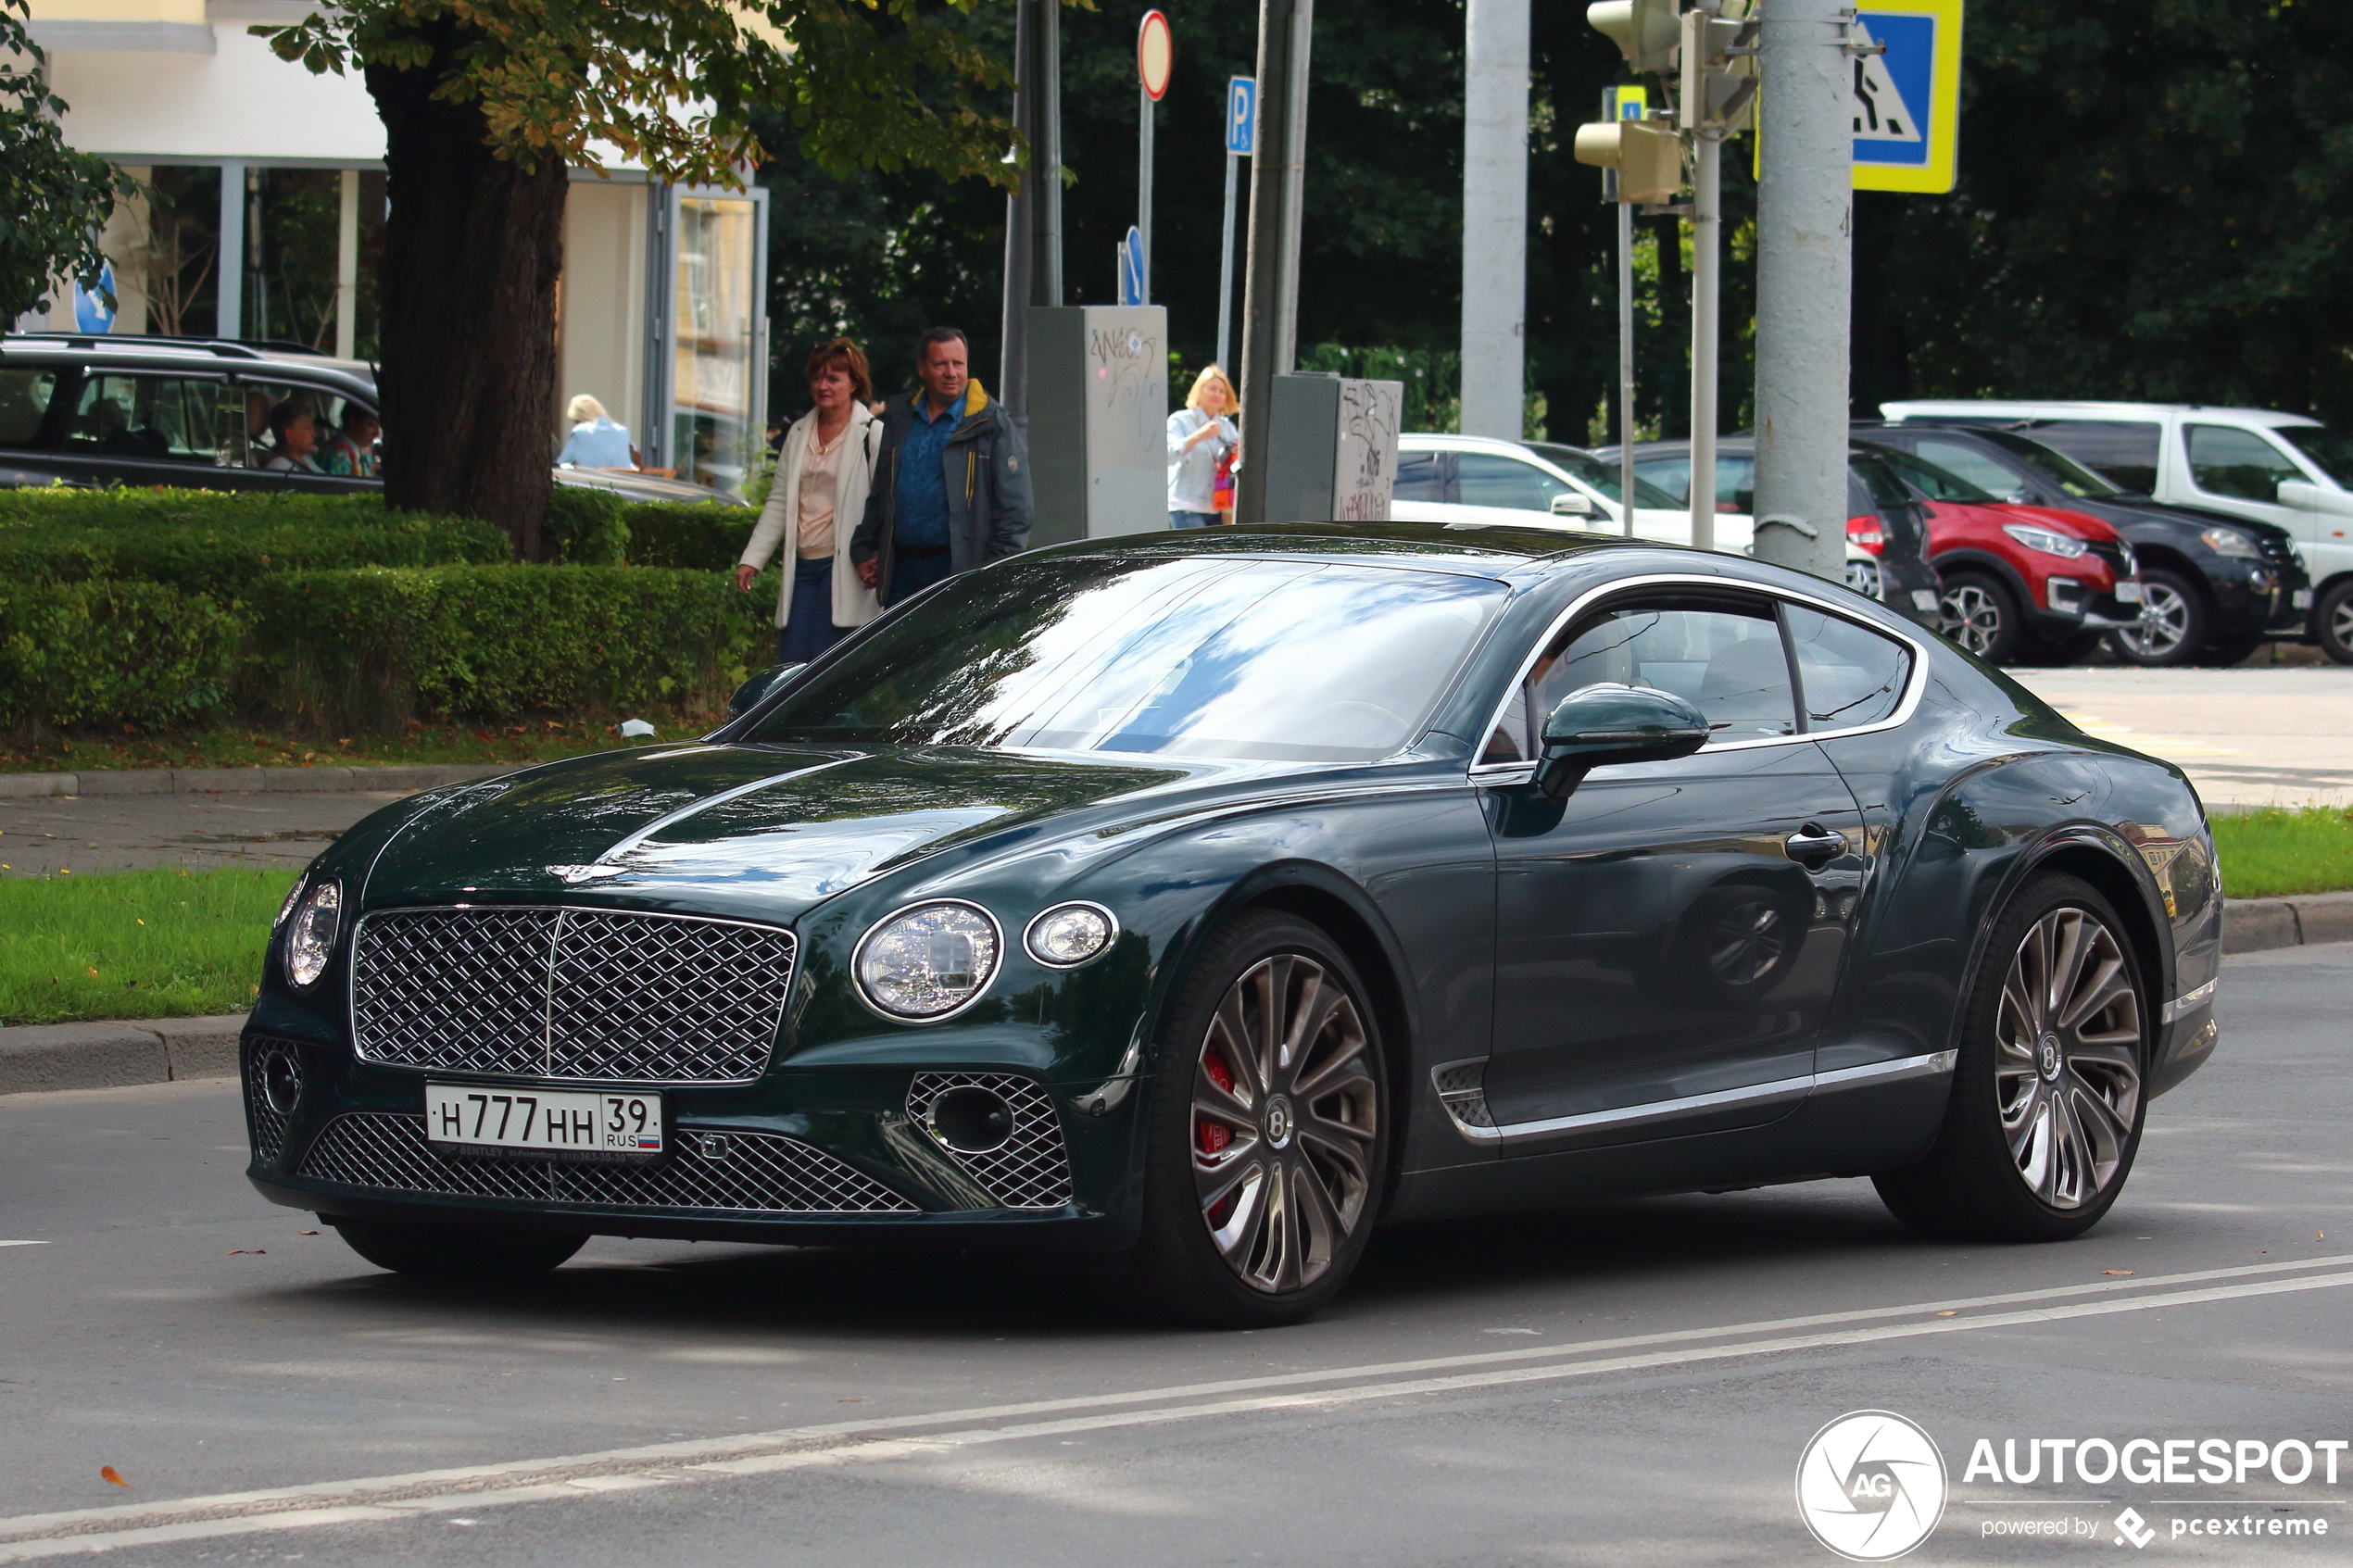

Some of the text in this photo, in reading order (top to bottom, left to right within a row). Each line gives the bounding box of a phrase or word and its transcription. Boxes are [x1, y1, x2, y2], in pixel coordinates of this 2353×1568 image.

[1233, 86, 1249, 144] P
[607, 1098, 648, 1134] 39
[459, 1146, 503, 1157] BENTLEY
[607, 1135, 636, 1148] RUS
